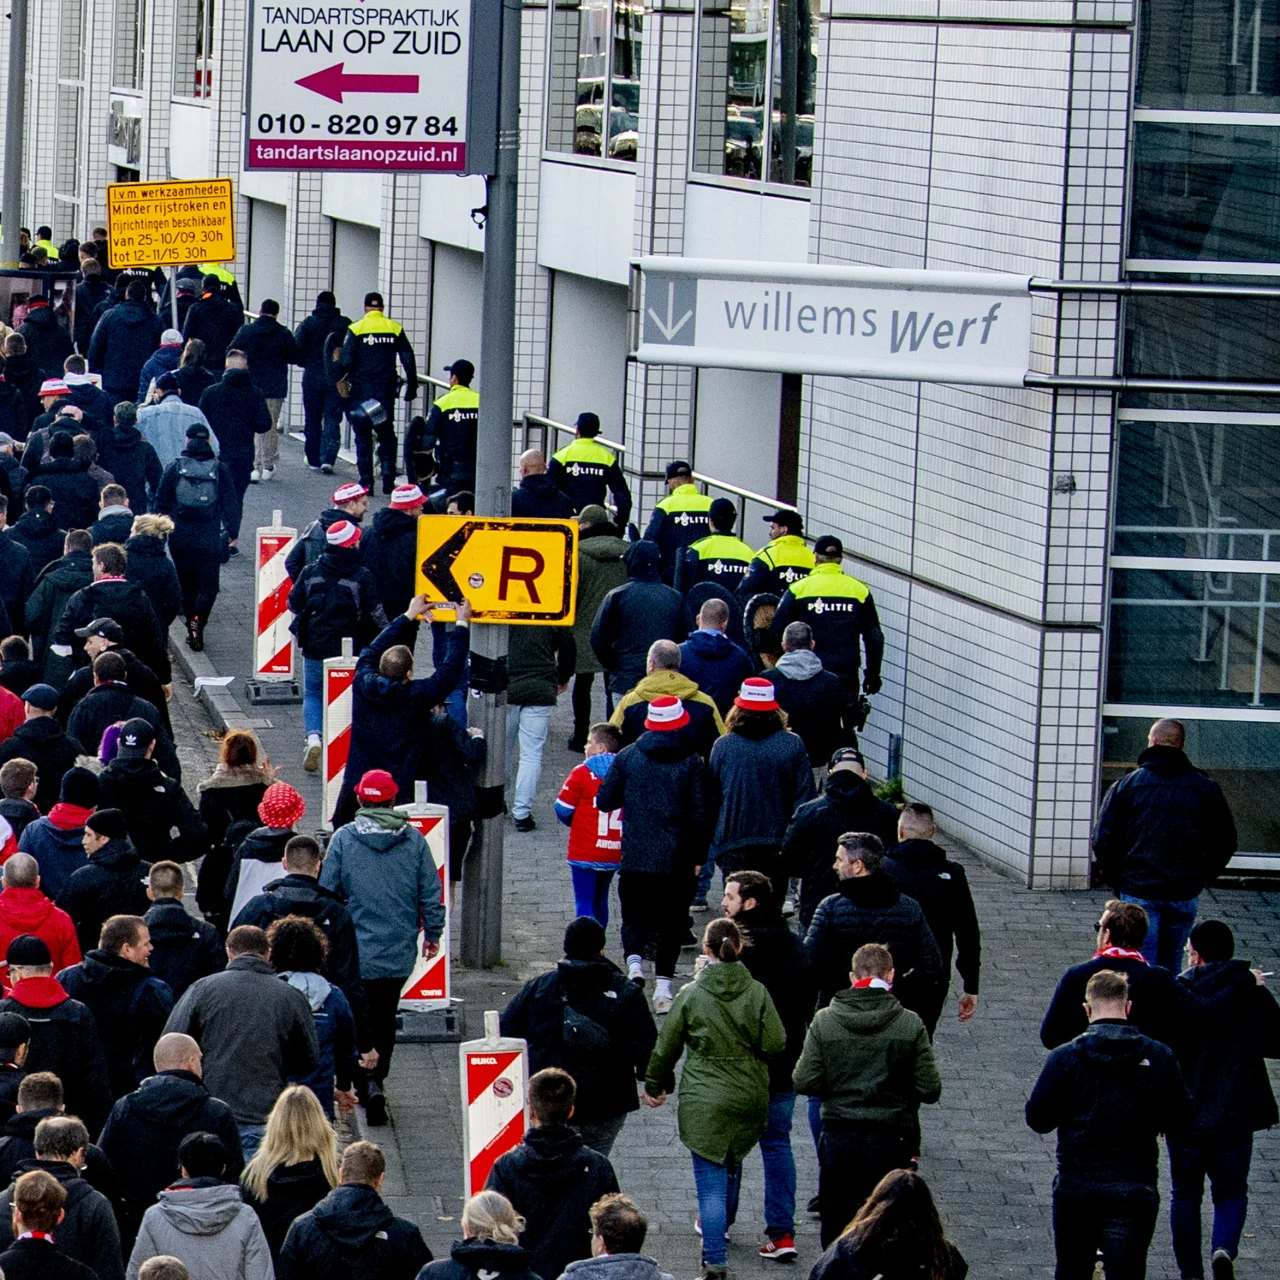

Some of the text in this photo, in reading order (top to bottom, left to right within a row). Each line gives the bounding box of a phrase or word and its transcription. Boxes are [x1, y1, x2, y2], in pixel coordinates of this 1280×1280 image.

[262, 6, 460, 26] TANDARTSPRAKTIJK
[260, 28, 462, 55] LAAN OP ZUID
[258, 113, 305, 134] 010
[327, 114, 378, 135] 820
[385, 115, 418, 136] 97
[424, 116, 458, 136] 84
[256, 144, 458, 164] tandartslaanopzuid.nl
[141, 184, 226, 198] werkzaamheden
[112, 200, 226, 216] Minder rijstroken en
[112, 215, 226, 235] rijrichtingen beschikbaar
[113, 237, 134, 247] van
[114, 251, 130, 262] tot
[362, 336, 394, 344] POLITIE
[448, 411, 478, 421] POLITI
[566, 464, 604, 476] POLITIE
[674, 514, 708, 526] POLITI
[498, 546, 545, 604] R
[808, 600, 854, 613] POLITIE
